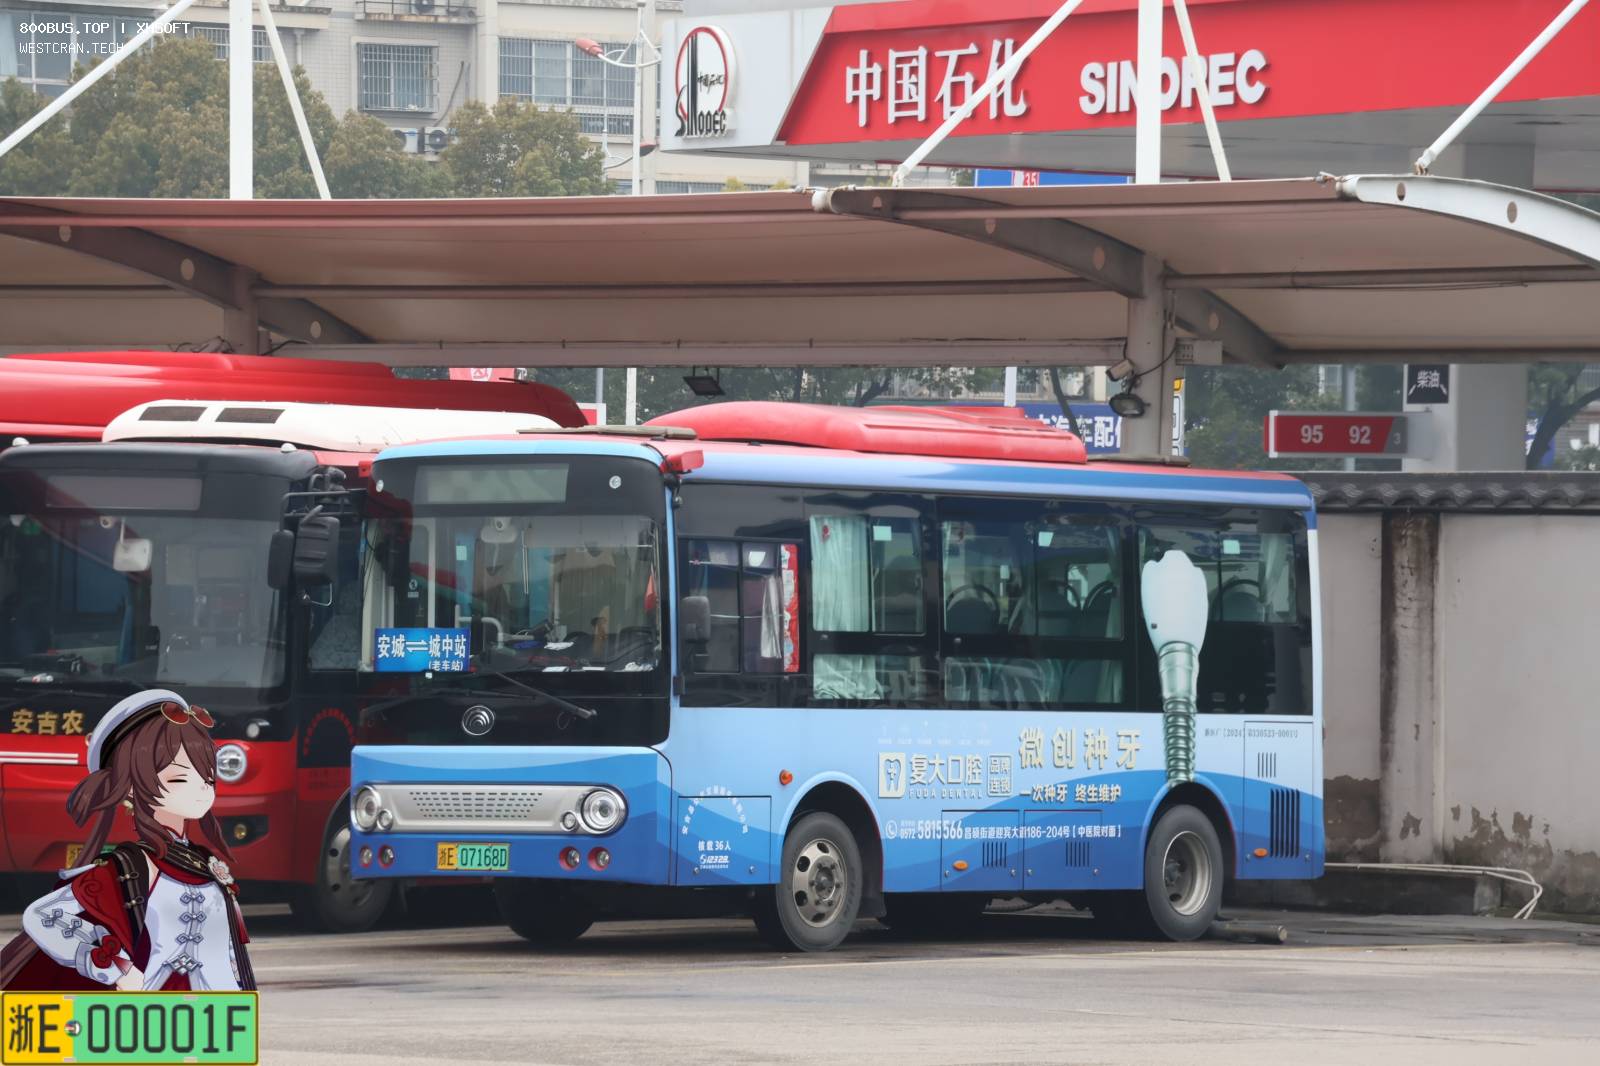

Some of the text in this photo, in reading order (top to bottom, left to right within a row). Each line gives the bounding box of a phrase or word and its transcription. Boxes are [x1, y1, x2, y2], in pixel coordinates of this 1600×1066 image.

[845, 38, 1028, 128] 中国石化
[1416, 370, 1441, 388] 柴油
[1300, 424, 1323, 443] 95
[1348, 426, 1371, 444] 92
[377, 633, 467, 658] 安城 城中站
[11, 708, 84, 736] 安吉农
[1019, 727, 1141, 771] 微创种牙
[910, 753, 982, 786] 复大口腔
[909, 787, 982, 800] FUDA DENTAL
[1020, 783, 1121, 803] 一次种牙 终生维护
[917, 819, 963, 840] 5815566
[460, 847, 507, 867] 07168D
